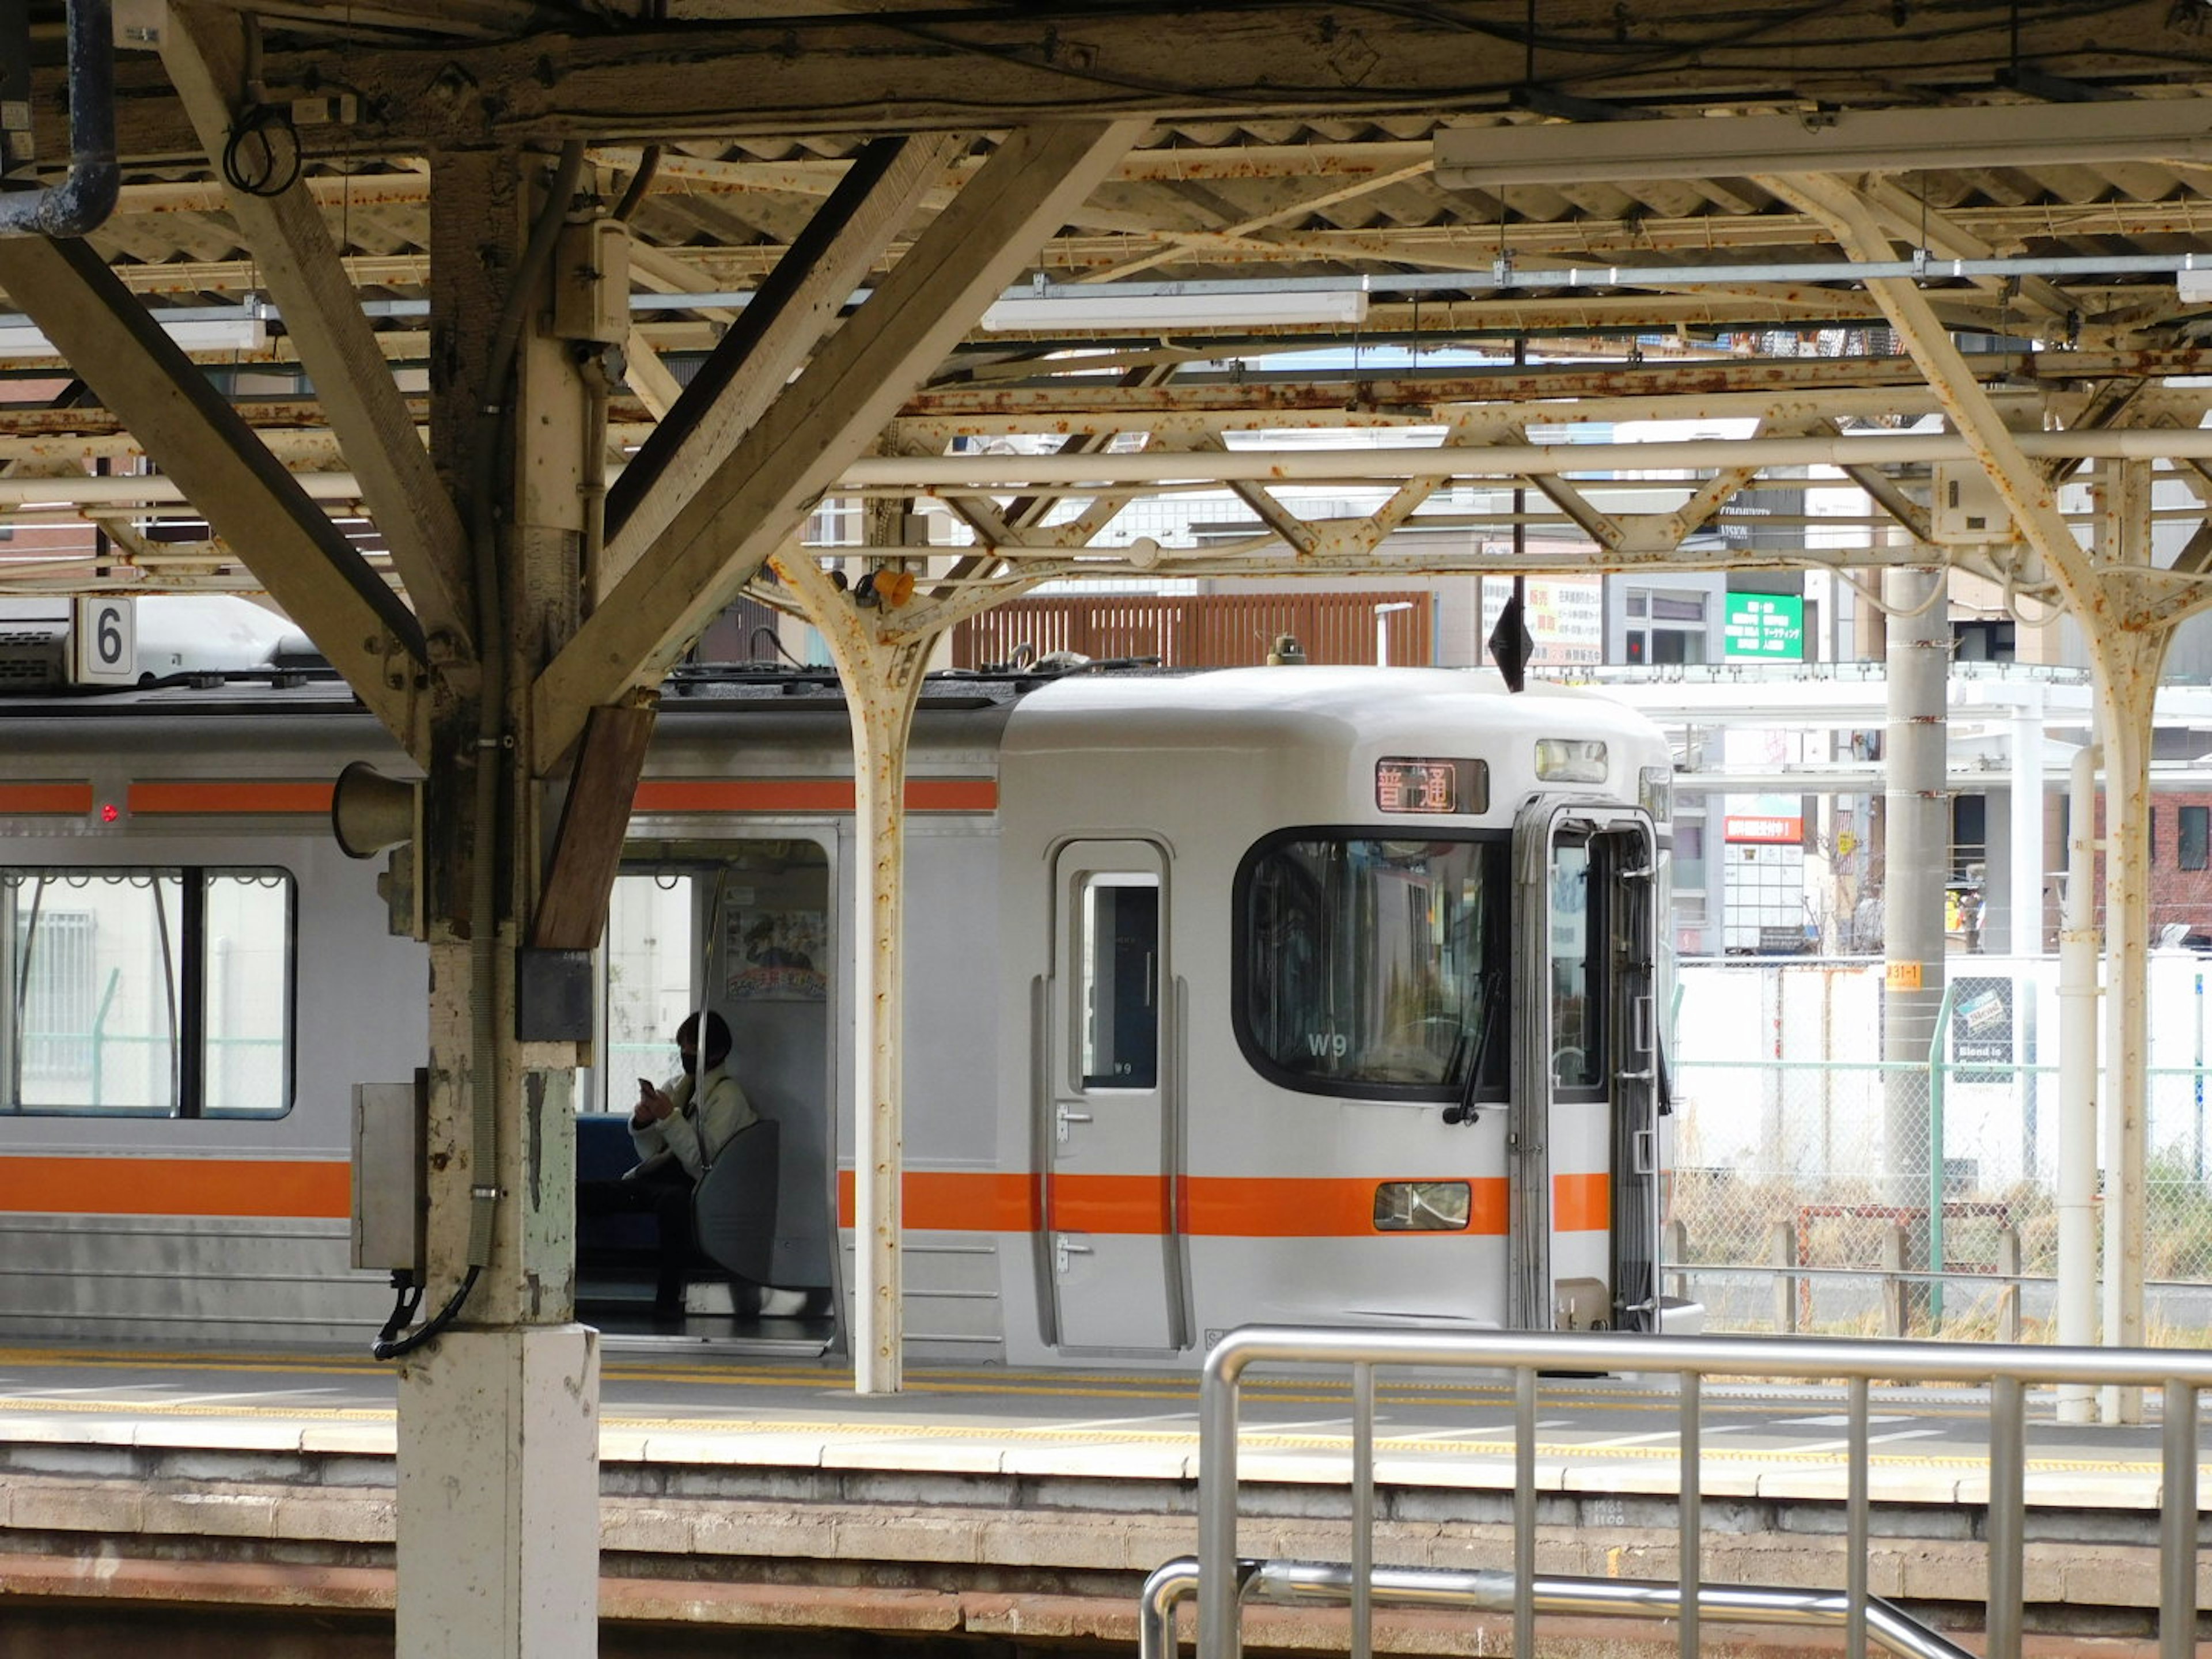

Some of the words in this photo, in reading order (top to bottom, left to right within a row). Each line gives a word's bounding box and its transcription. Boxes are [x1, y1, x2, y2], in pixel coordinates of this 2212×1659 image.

[99, 608, 122, 664] 6
[1378, 767, 1446, 806] 普通
[1308, 1033, 1347, 1058] W9
